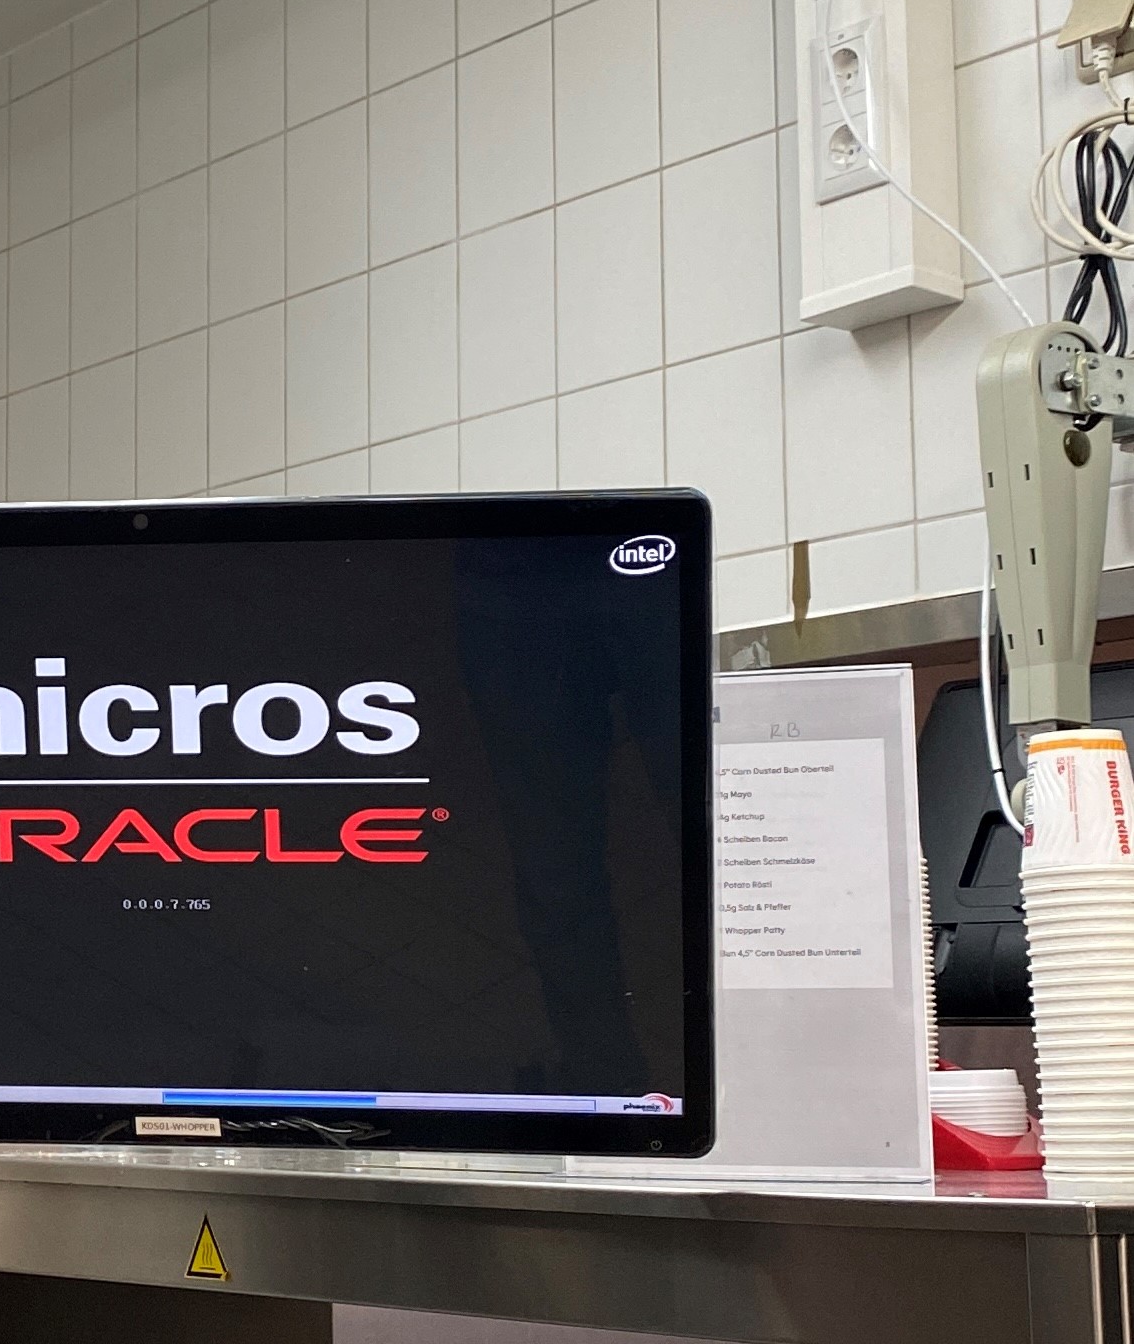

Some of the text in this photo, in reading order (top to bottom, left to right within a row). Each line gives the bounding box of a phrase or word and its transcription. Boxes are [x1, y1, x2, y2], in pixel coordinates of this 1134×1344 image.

[730, 790, 753, 800] Mayo
[1107, 760, 1131, 855] BURGER KING
[731, 813, 765, 822] Ketchup
[762, 834, 789, 843] Bacon
[723, 858, 762, 867] Scheiben
[723, 881, 751, 889] Potato
[738, 903, 755, 912] Salz
[756, 903, 763, 911] &
[724, 926, 786, 936] Whopper Patty
[807, 948, 824, 956] Bun
